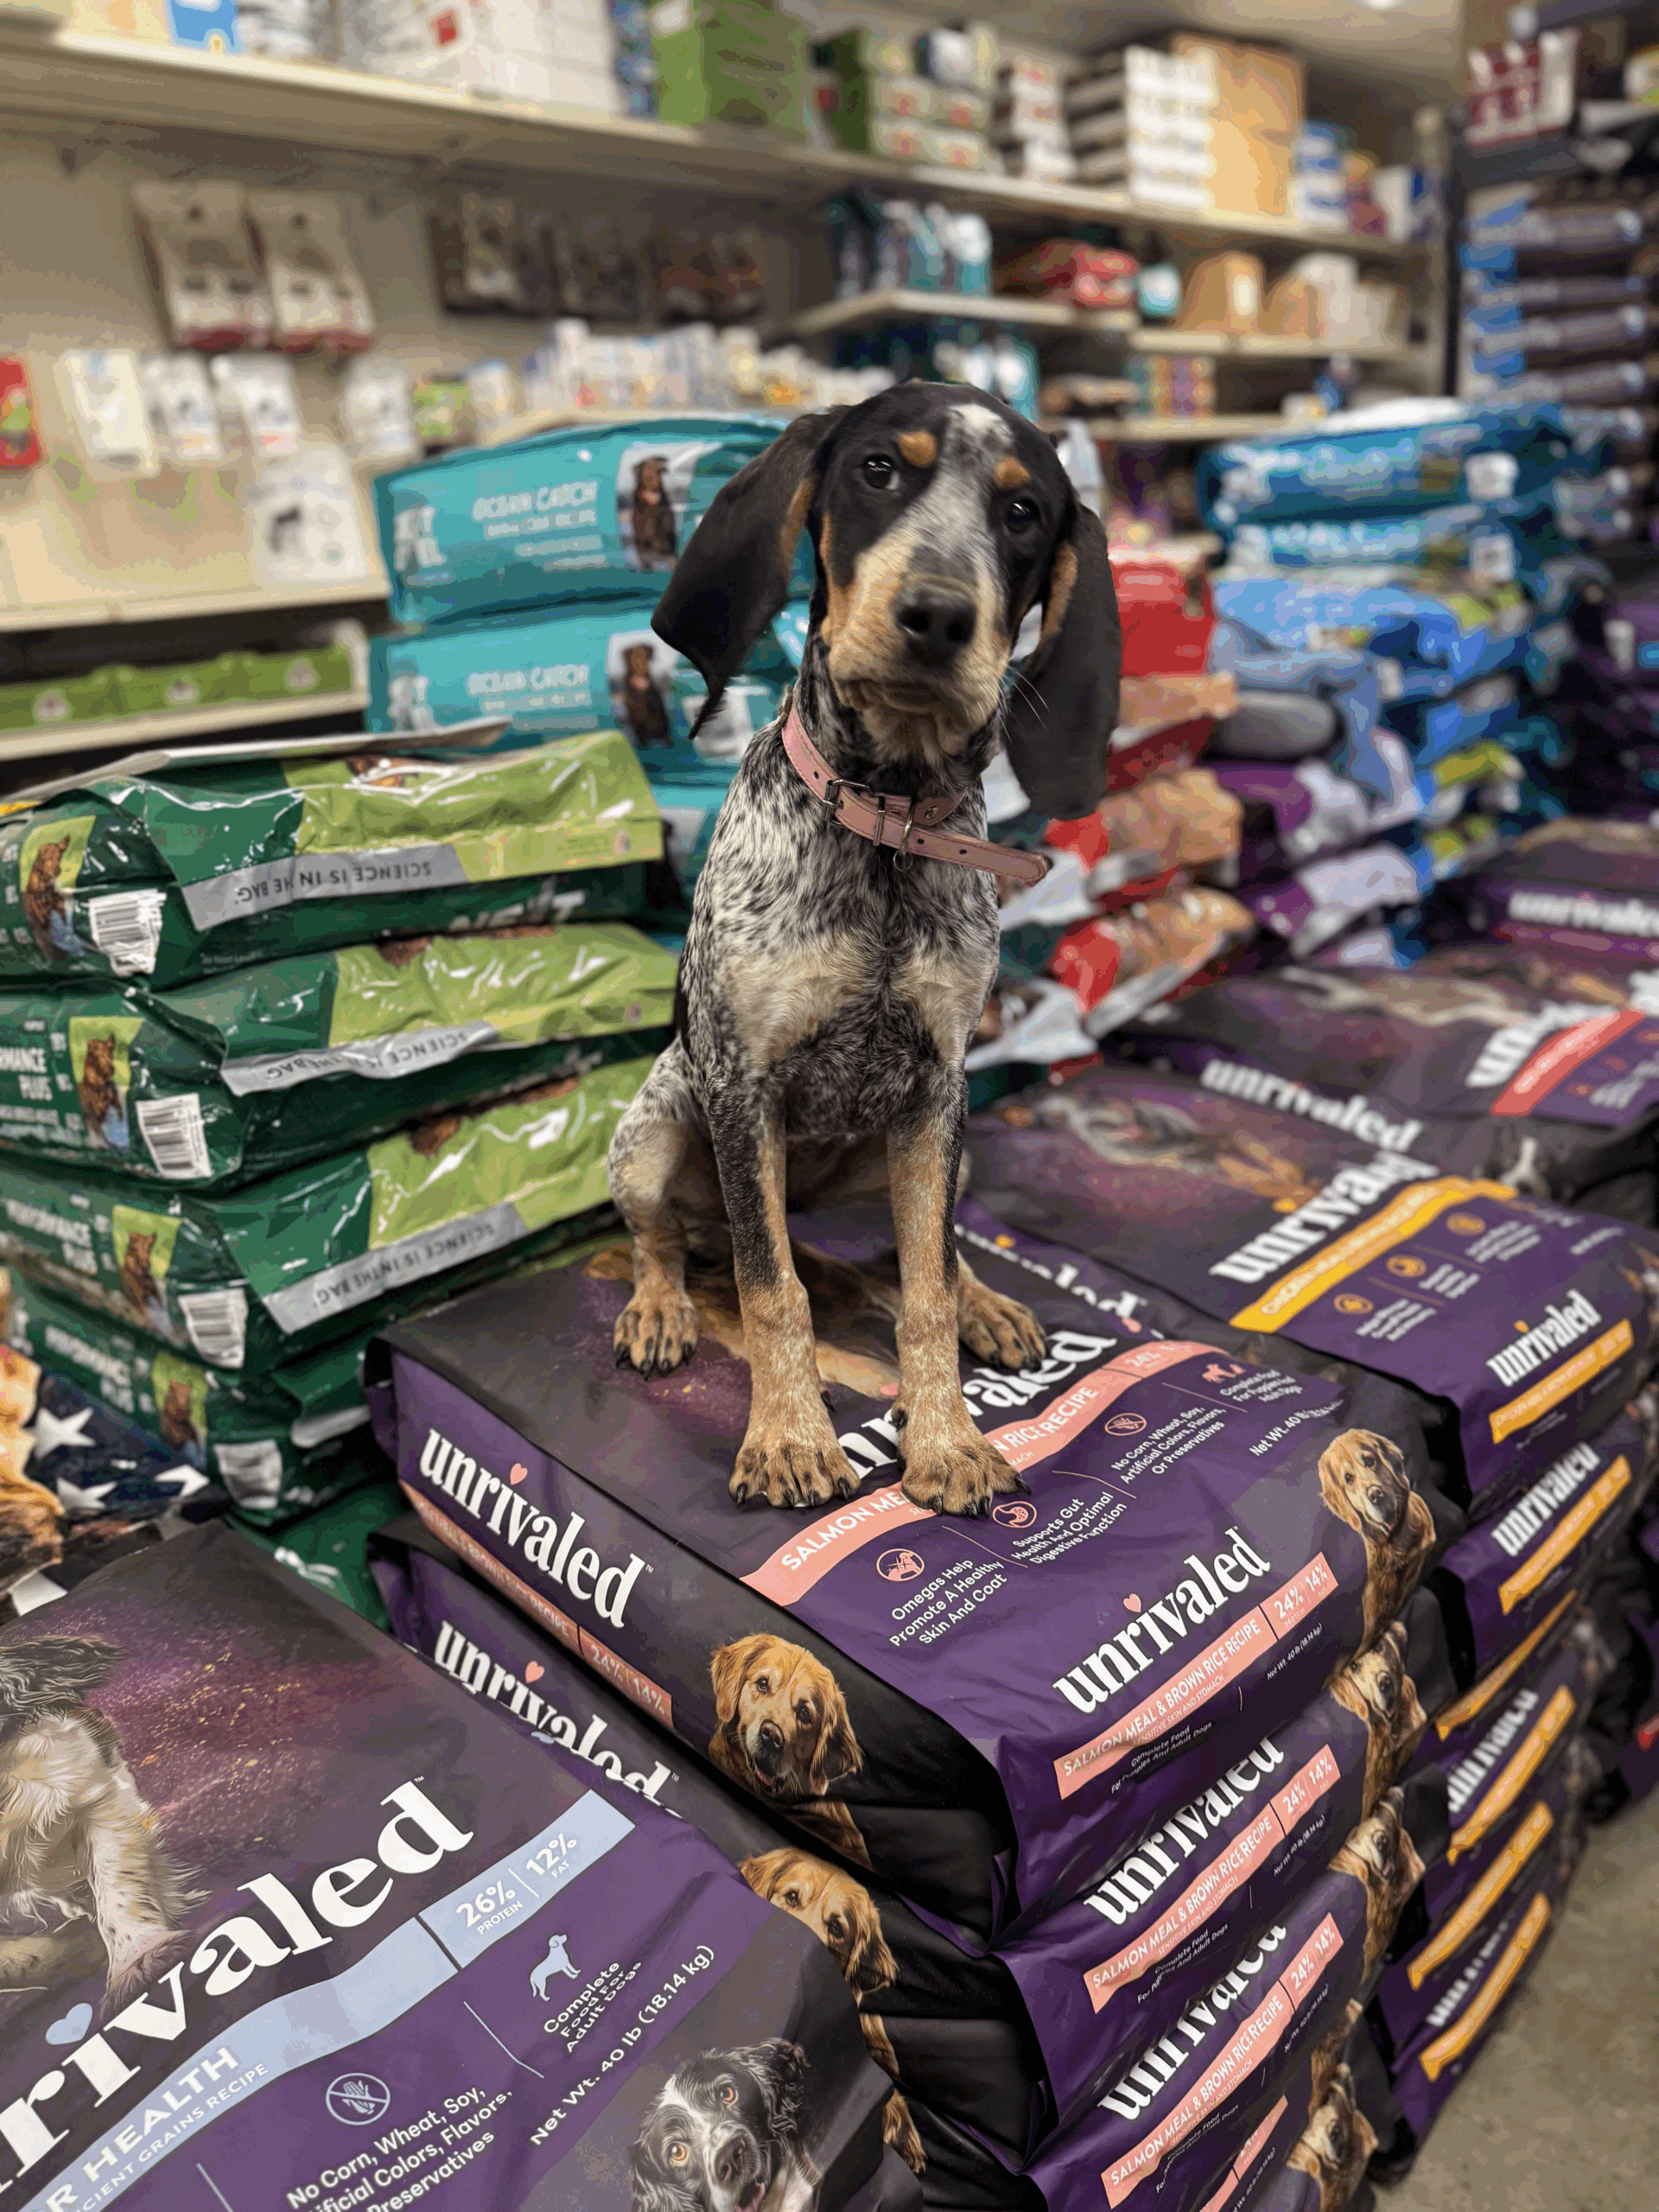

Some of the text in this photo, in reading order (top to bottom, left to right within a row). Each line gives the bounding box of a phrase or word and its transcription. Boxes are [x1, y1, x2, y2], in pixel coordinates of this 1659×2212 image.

[299, 870, 321, 886] IN
[329, 868, 347, 884] IS
[354, 861, 432, 882] SCIENCE
[1209, 1151, 1439, 1283] unriva
[1485, 1289, 1601, 1387] unrivaled
[1009, 1450, 1034, 1467] MACH
[1111, 1407, 1205, 1471] No Corn, Wheat, Soy,
[1120, 1408, 1227, 1484] Artificial Colors, Flavors,
[1152, 1421, 1225, 1475] Or Preservatives
[1249, 1416, 1301, 1456] Net Wt. 40
[781, 1506, 876, 1571] SALMON
[868, 1491, 912, 1514] ME
[1038, 1386, 1099, 1435] RECIPE
[420, 1428, 645, 1628] unrivaled
[1011, 1491, 1114, 1560] Health And Optimal
[1013, 1498, 1084, 1548] Supports Gut
[1029, 1503, 1127, 1564] Digestive Function
[889, 1560, 1005, 1647] Promote A Healthy
[892, 1559, 974, 1620] Omegas Help
[1274, 1586, 1305, 1618] 24%
[1305, 1562, 1328, 1592] 14%
[918, 1573, 1007, 1644] Skin And Coat
[1052, 1526, 1271, 1713] unrivaled
[1064, 1618, 1261, 1777] SALMON MEAL & BROWN RICE RECIPE
[1181, 1697, 1198, 1715] AND
[1195, 1674, 1225, 1705] STOMACH
[1267, 1667, 1277, 1681] Net
[1131, 1725, 1190, 1767] Complete Food
[1308, 1755, 1332, 1785] 14%
[1111, 1778, 1122, 1795] For
[1282, 1781, 1306, 1815] 24%
[525, 1832, 577, 1878] 12%
[550, 1858, 572, 1878] FAT
[454, 1878, 517, 1928] 26%
[477, 1898, 524, 1936] PROTEIN
[1092, 1815, 1273, 1989] SALMON MEAL & BROWN RICE RECIPE
[1137, 1989, 1151, 2005] For
[1211, 1923, 1229, 1942] Dogs
[1157, 1926, 1187, 1957] SENSITIVE
[1187, 1914, 1202, 1931] SKIN
[1192, 1928, 1209, 1948] Food
[1314, 1925, 1335, 1955] 14%
[0, 1781, 474, 2192] rivaled
[543, 1961, 620, 2034] Complete
[1291, 1954, 1314, 1989] 24%
[560, 1970, 625, 2038] Food For
[566, 1961, 642, 2053] Adult Dogs
[530, 1945, 715, 2146] Net Wt. 40 lb (18.14 kg)
[1227, 2057, 1253, 2091] STOMACH
[83, 2046, 239, 2183] HEALTH
[1110, 2133, 1165, 2186] SALMON
[1164, 2106, 1193, 2140] MEAL
[1192, 2095, 1202, 2112] &
[1199, 2060, 1236, 2101] BROWN
[1231, 2031, 1254, 2062] RICE
[1247, 1995, 1284, 2040] RECIPE
[75, 2063, 270, 2212] CIENT GRAINS RECIPE
[286, 2086, 486, 2210] No Corn, Wheat, Soy,
[310, 2089, 513, 2212] ficial Colors, Flavors,
